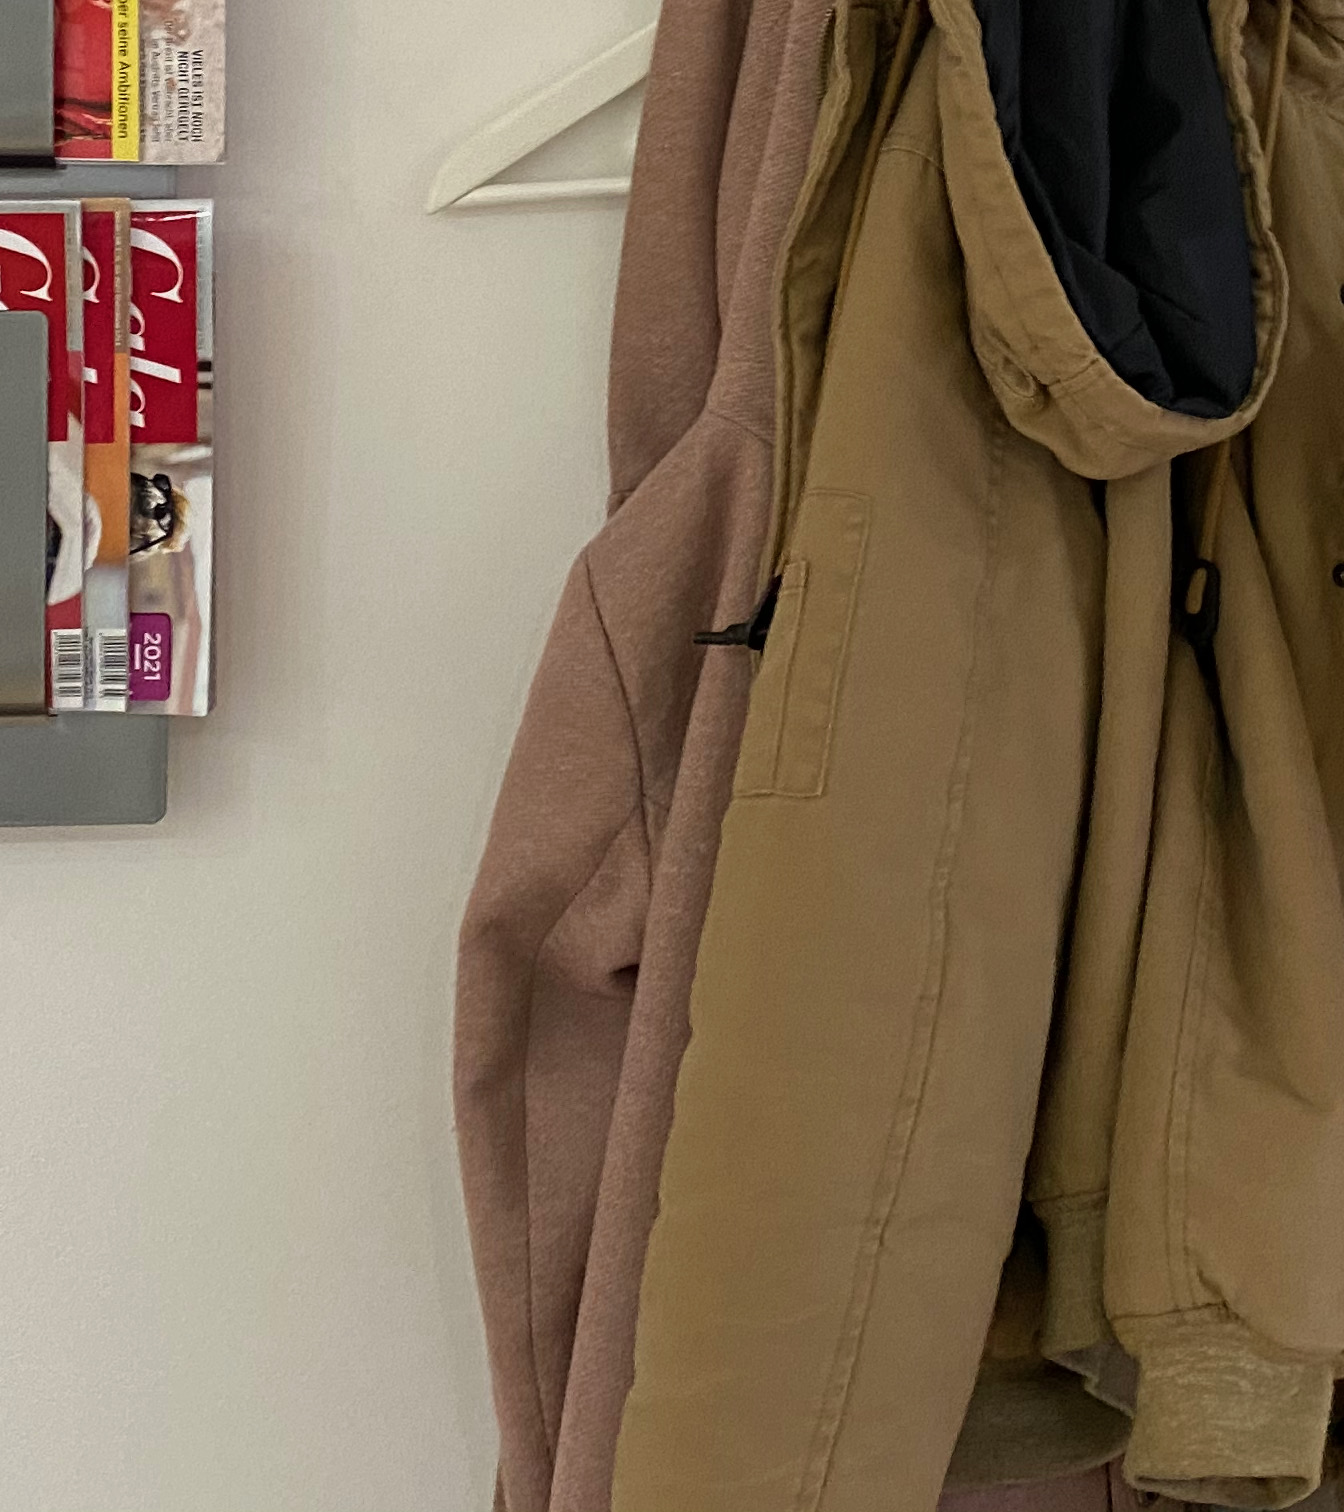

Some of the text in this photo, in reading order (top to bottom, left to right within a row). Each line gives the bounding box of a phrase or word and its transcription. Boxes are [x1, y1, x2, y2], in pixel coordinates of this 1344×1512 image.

[117, 22, 132, 56] seine
[117, 61, 132, 139] Ambitionen
[143, 632, 162, 681] 2021
